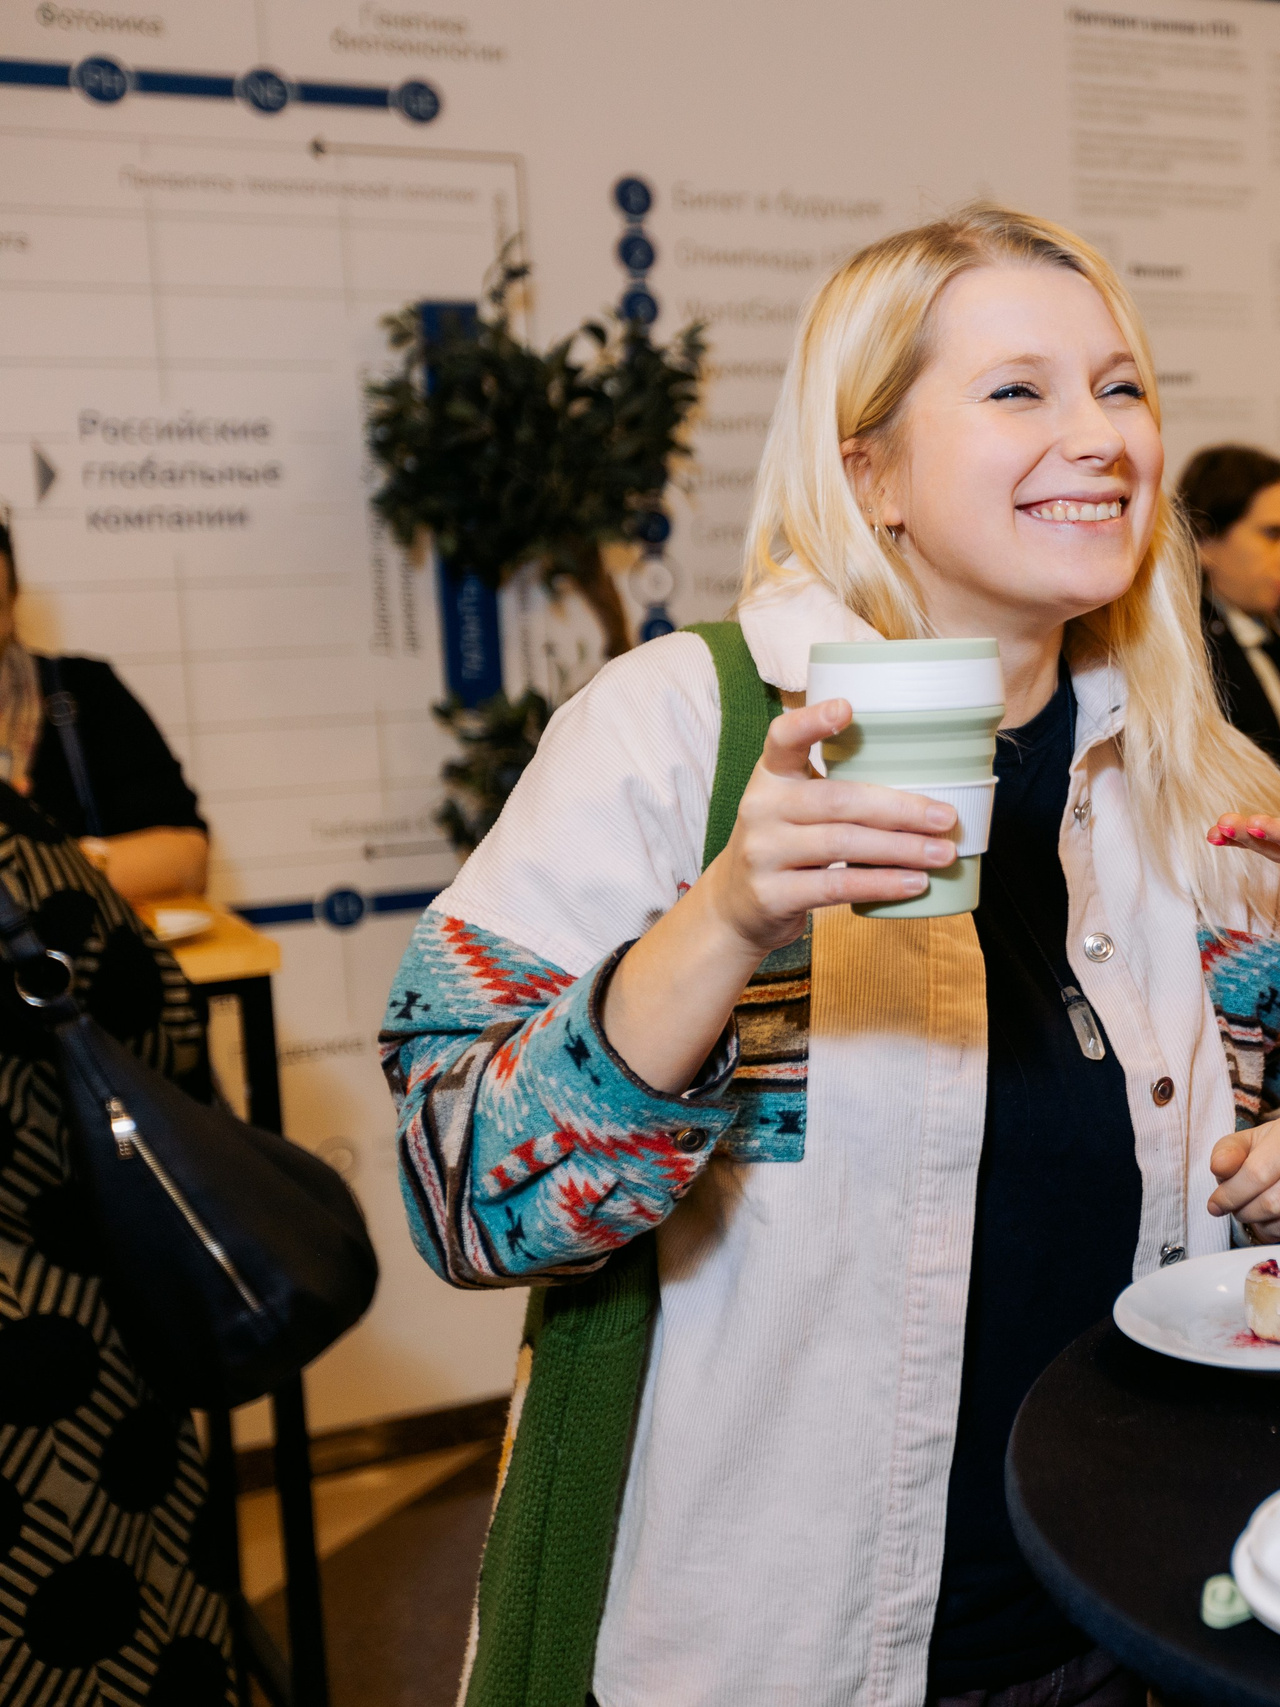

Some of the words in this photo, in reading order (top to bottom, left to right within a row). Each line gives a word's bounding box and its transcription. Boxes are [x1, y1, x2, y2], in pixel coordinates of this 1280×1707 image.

[77, 407, 273, 445] Российские
[81, 451, 284, 490] глобальные
[85, 502, 251, 534] компании
